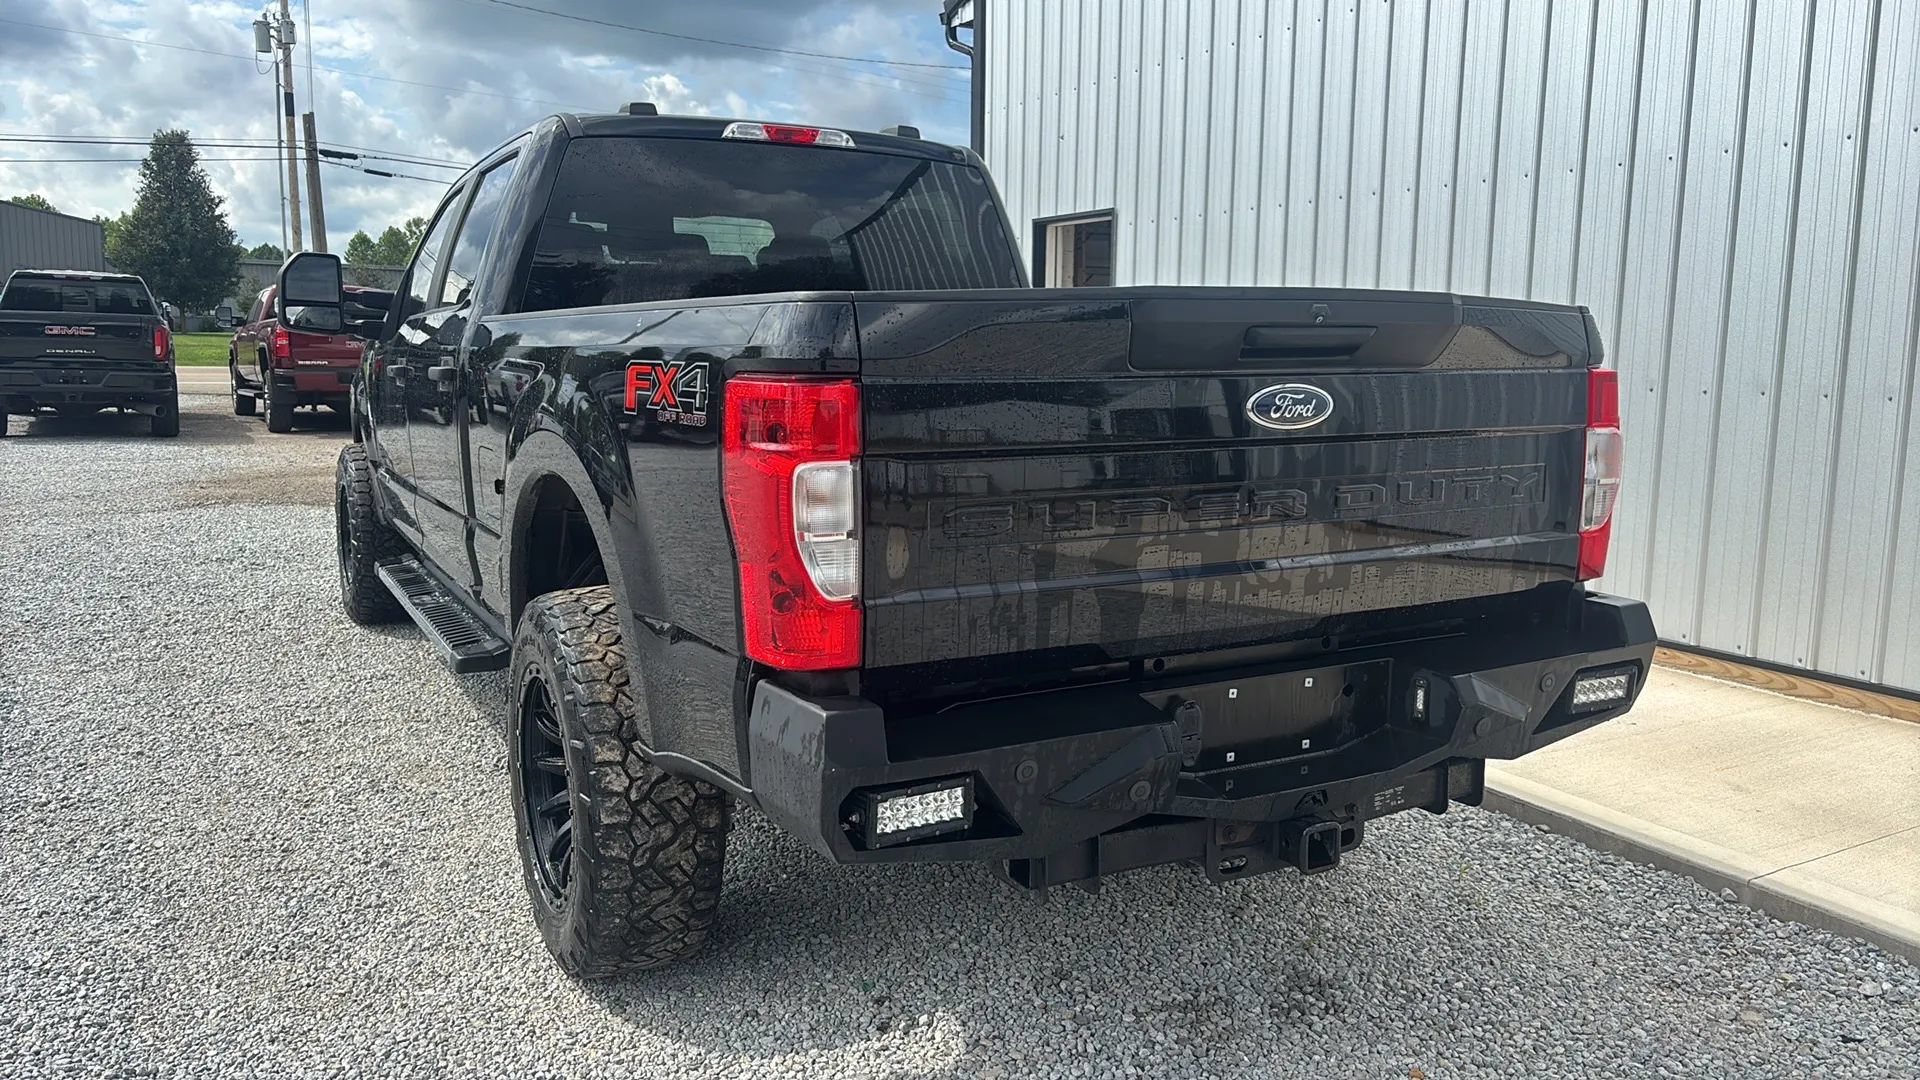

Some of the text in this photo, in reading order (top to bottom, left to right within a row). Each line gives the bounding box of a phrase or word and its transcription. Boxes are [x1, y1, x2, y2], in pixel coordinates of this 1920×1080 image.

[45, 325, 96, 336] GMC
[624, 360, 709, 415] FX4
[657, 410, 707, 427] OFF ROAD
[1270, 393, 1316, 419] Ford
[943, 471, 1539, 541] SUPER DUTY
